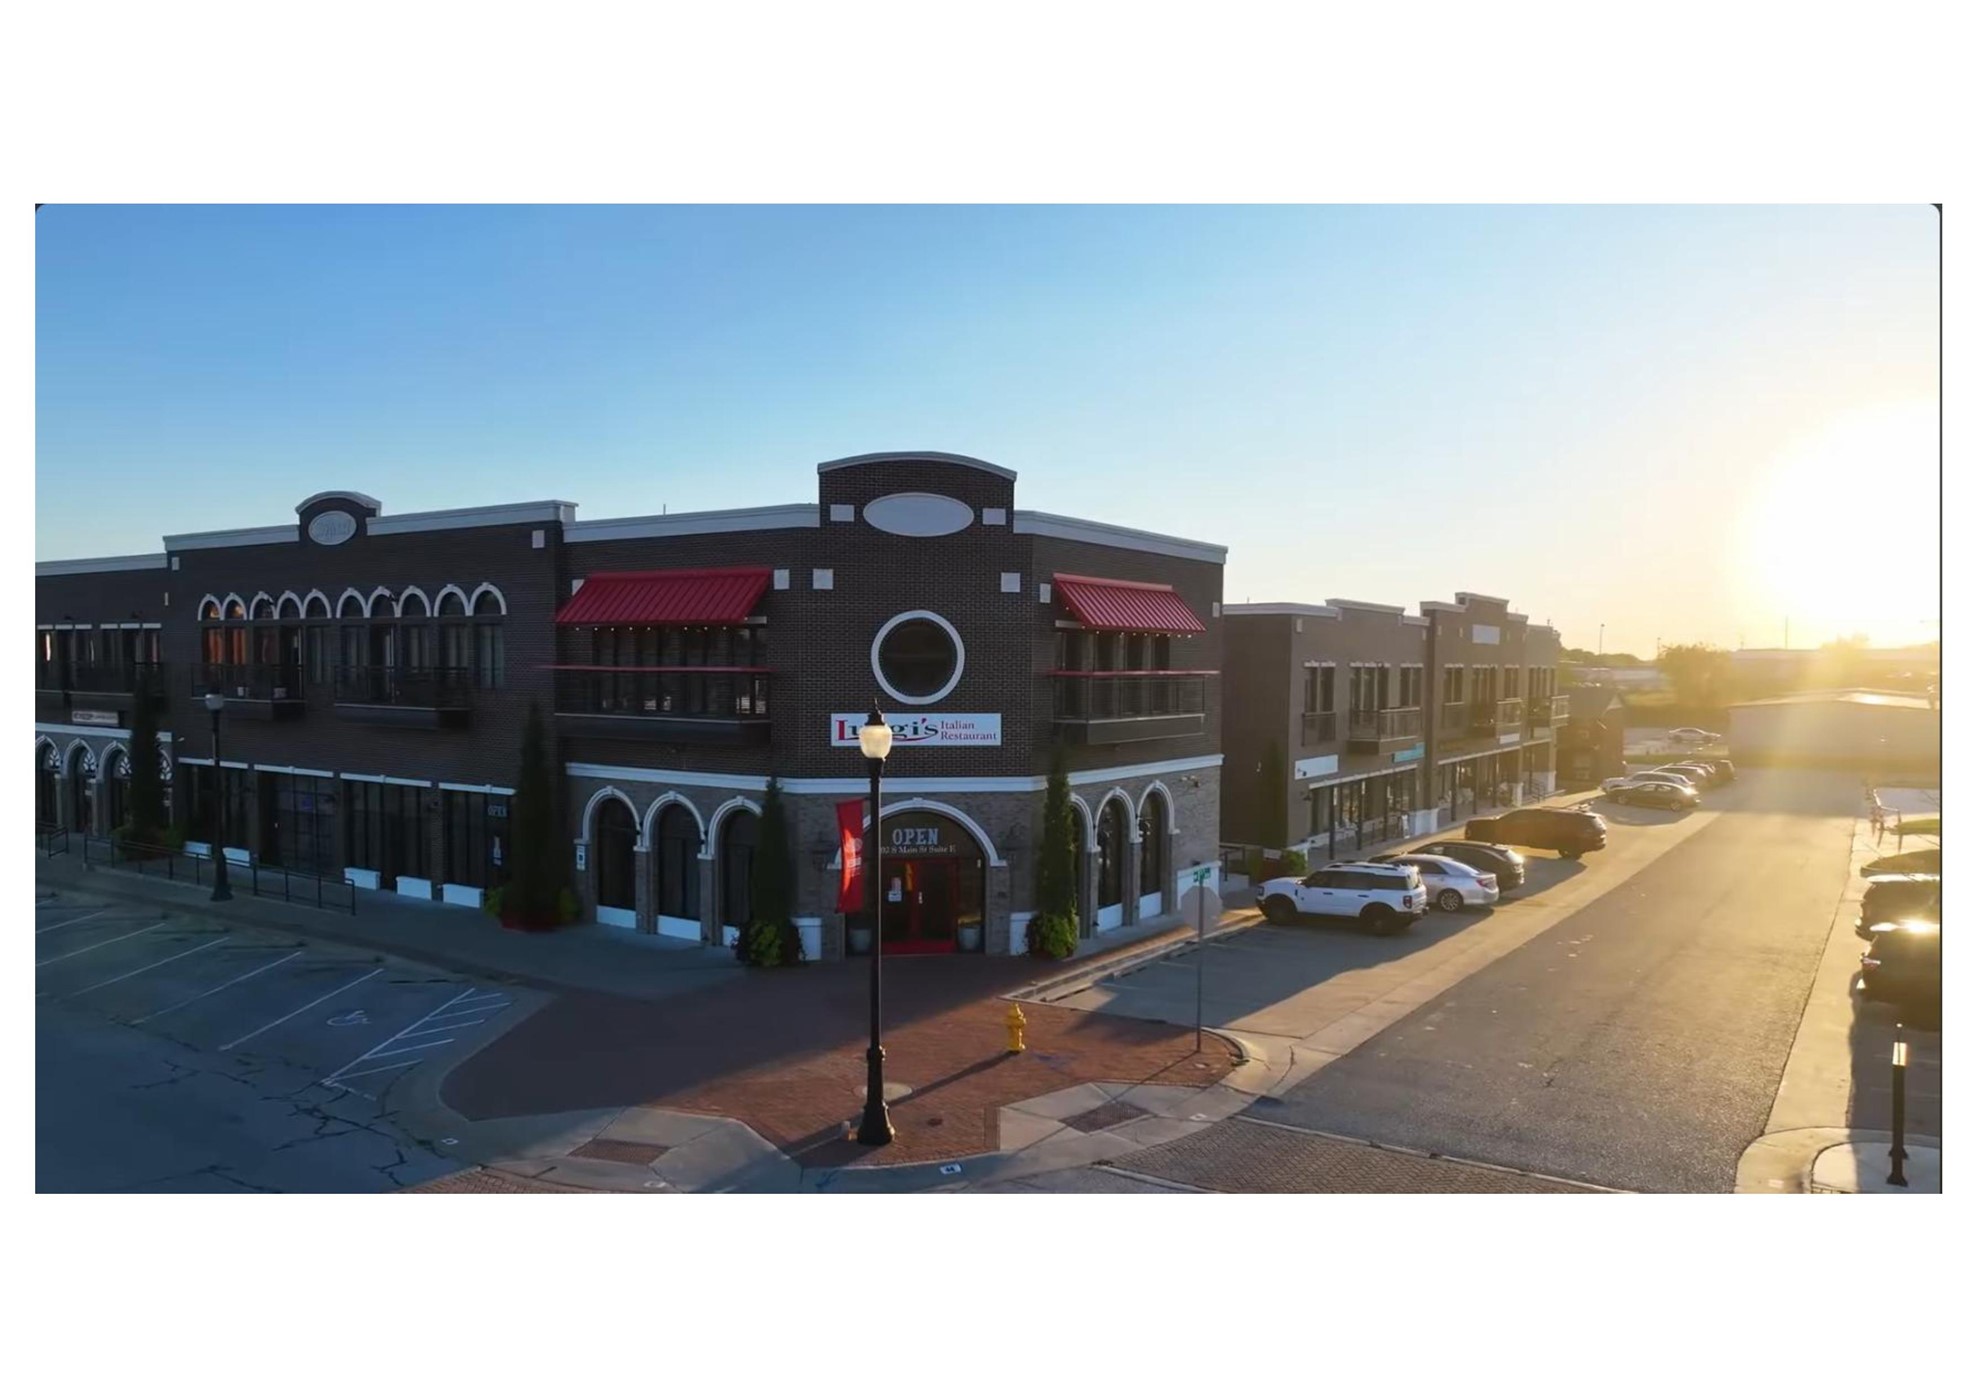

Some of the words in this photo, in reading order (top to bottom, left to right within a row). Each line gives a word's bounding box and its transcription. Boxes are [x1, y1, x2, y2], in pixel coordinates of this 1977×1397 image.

[835, 717, 939, 742] Lugi's
[940, 720, 975, 730] Italian
[940, 731, 997, 741] Restaurant
[892, 828, 939, 846] OPEN
[898, 845, 918, 854] Main
[929, 844, 949, 854] Suite
